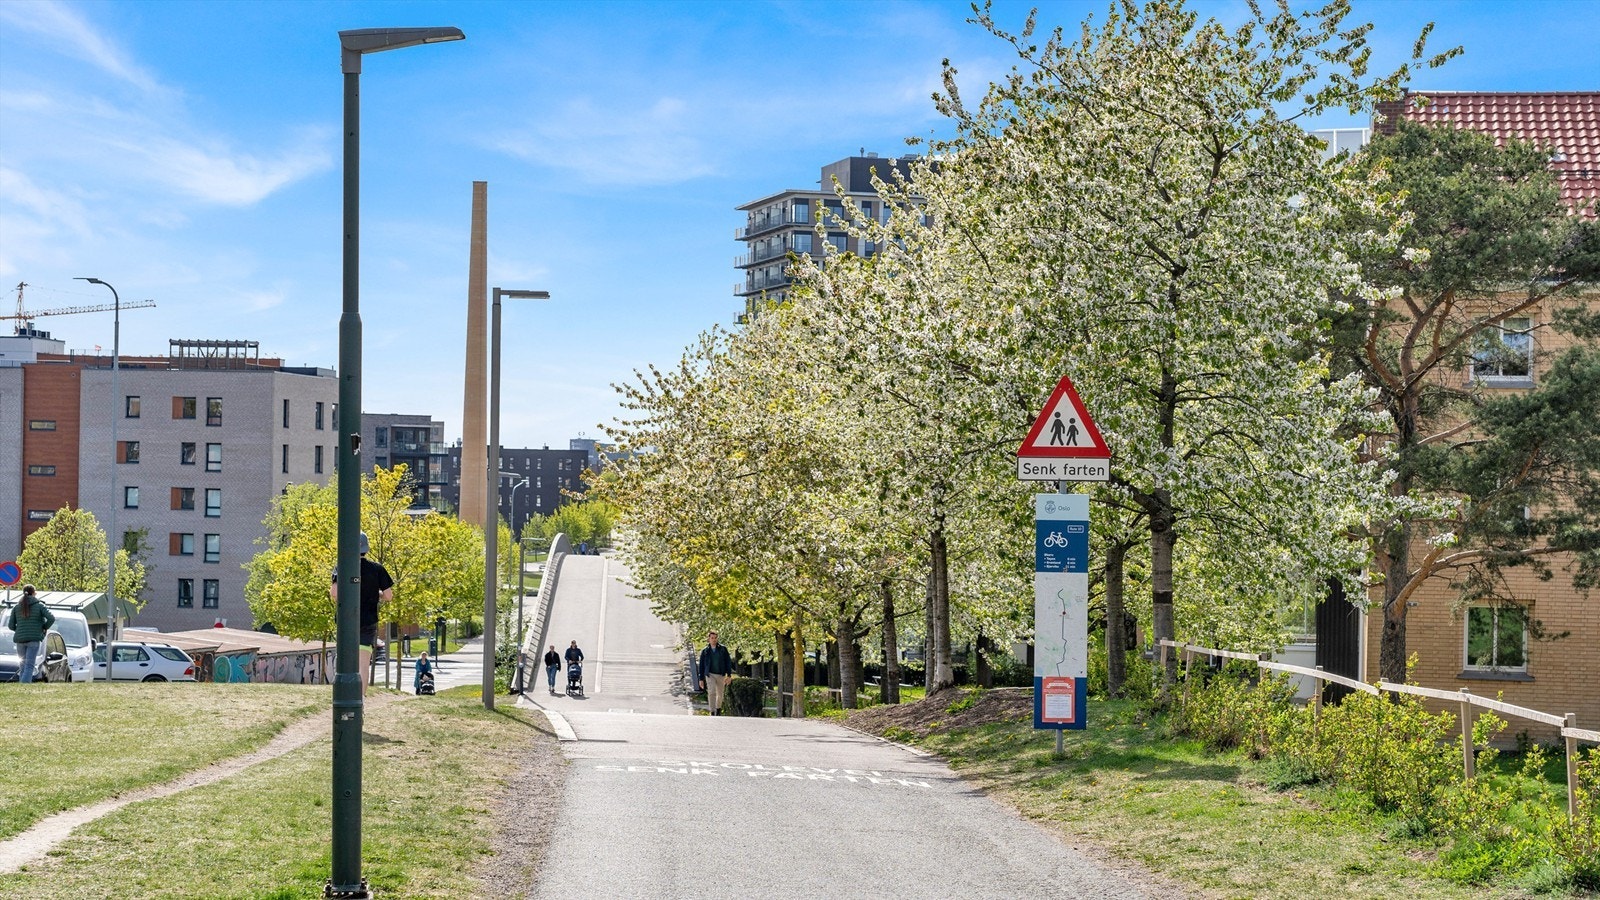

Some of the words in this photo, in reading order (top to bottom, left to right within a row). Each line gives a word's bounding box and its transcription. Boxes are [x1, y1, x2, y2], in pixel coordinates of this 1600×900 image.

[1022, 462, 1057, 475] Senk
[1063, 463, 1105, 476] farten
[596, 765, 721, 777] SENK
[747, 771, 933, 788] FARTEN
